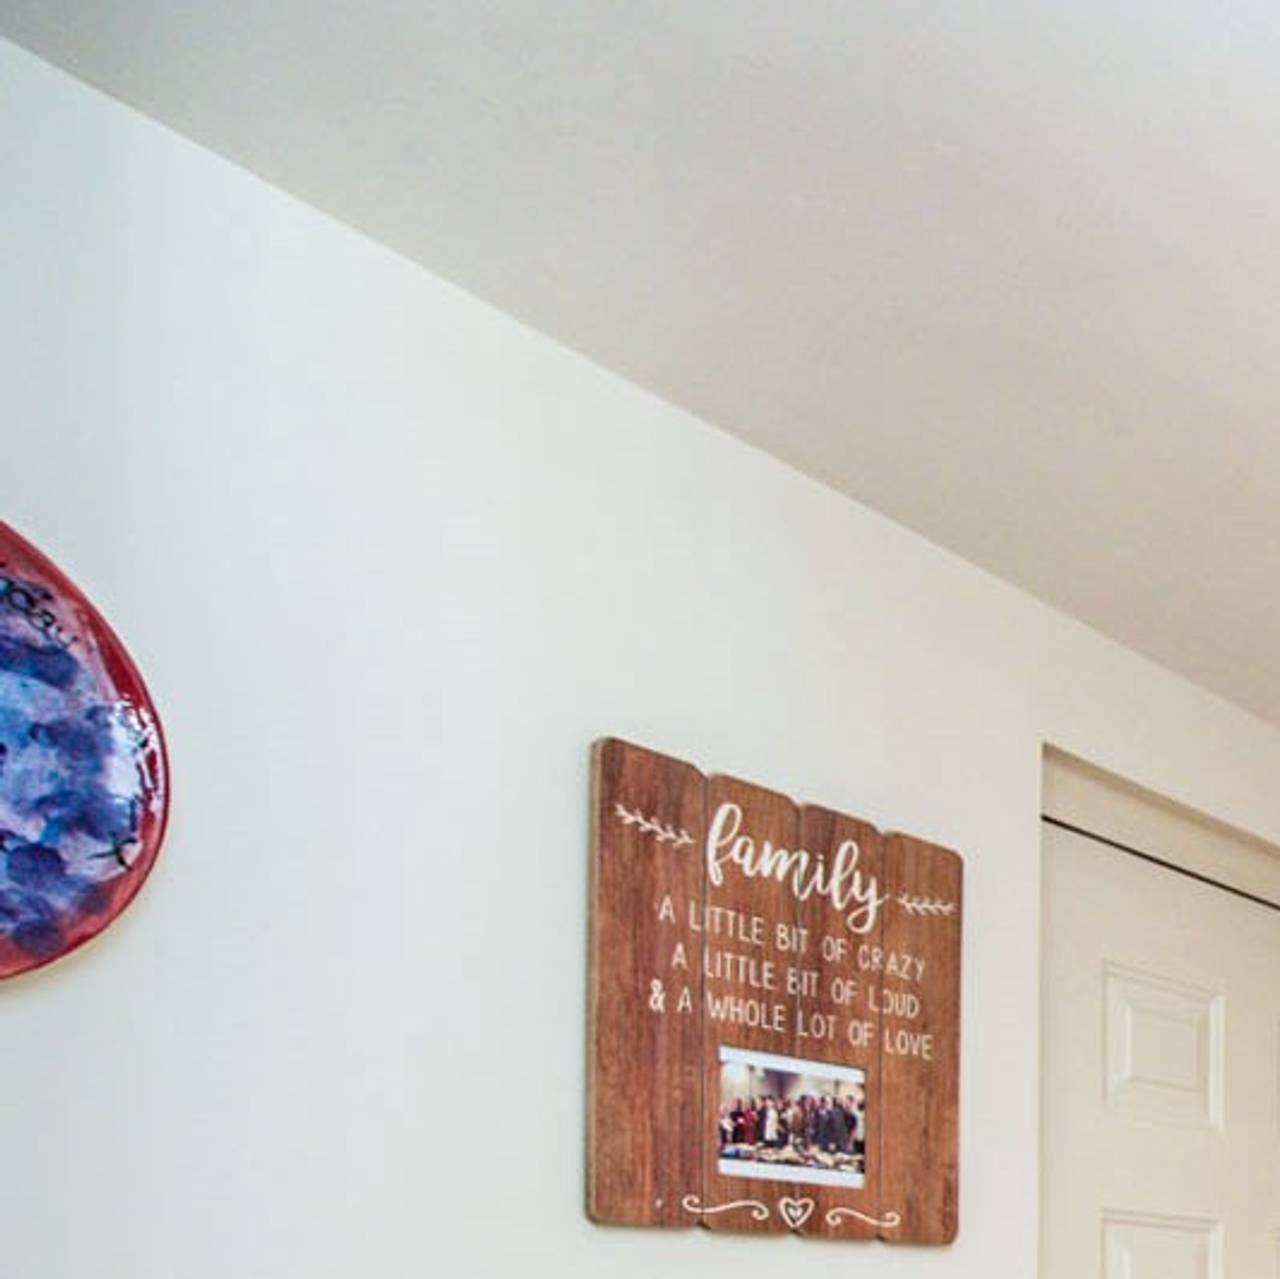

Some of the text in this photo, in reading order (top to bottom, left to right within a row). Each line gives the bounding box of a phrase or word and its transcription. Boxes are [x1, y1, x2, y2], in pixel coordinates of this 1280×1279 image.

[706, 802, 891, 934] family
[658, 895, 927, 983] A LITTLE BIT OF CRAZY
[671, 942, 920, 1020] A LITTLE BIT OF LOUD
[650, 978, 934, 1060] & A WHOLE LOT OF LOVE
